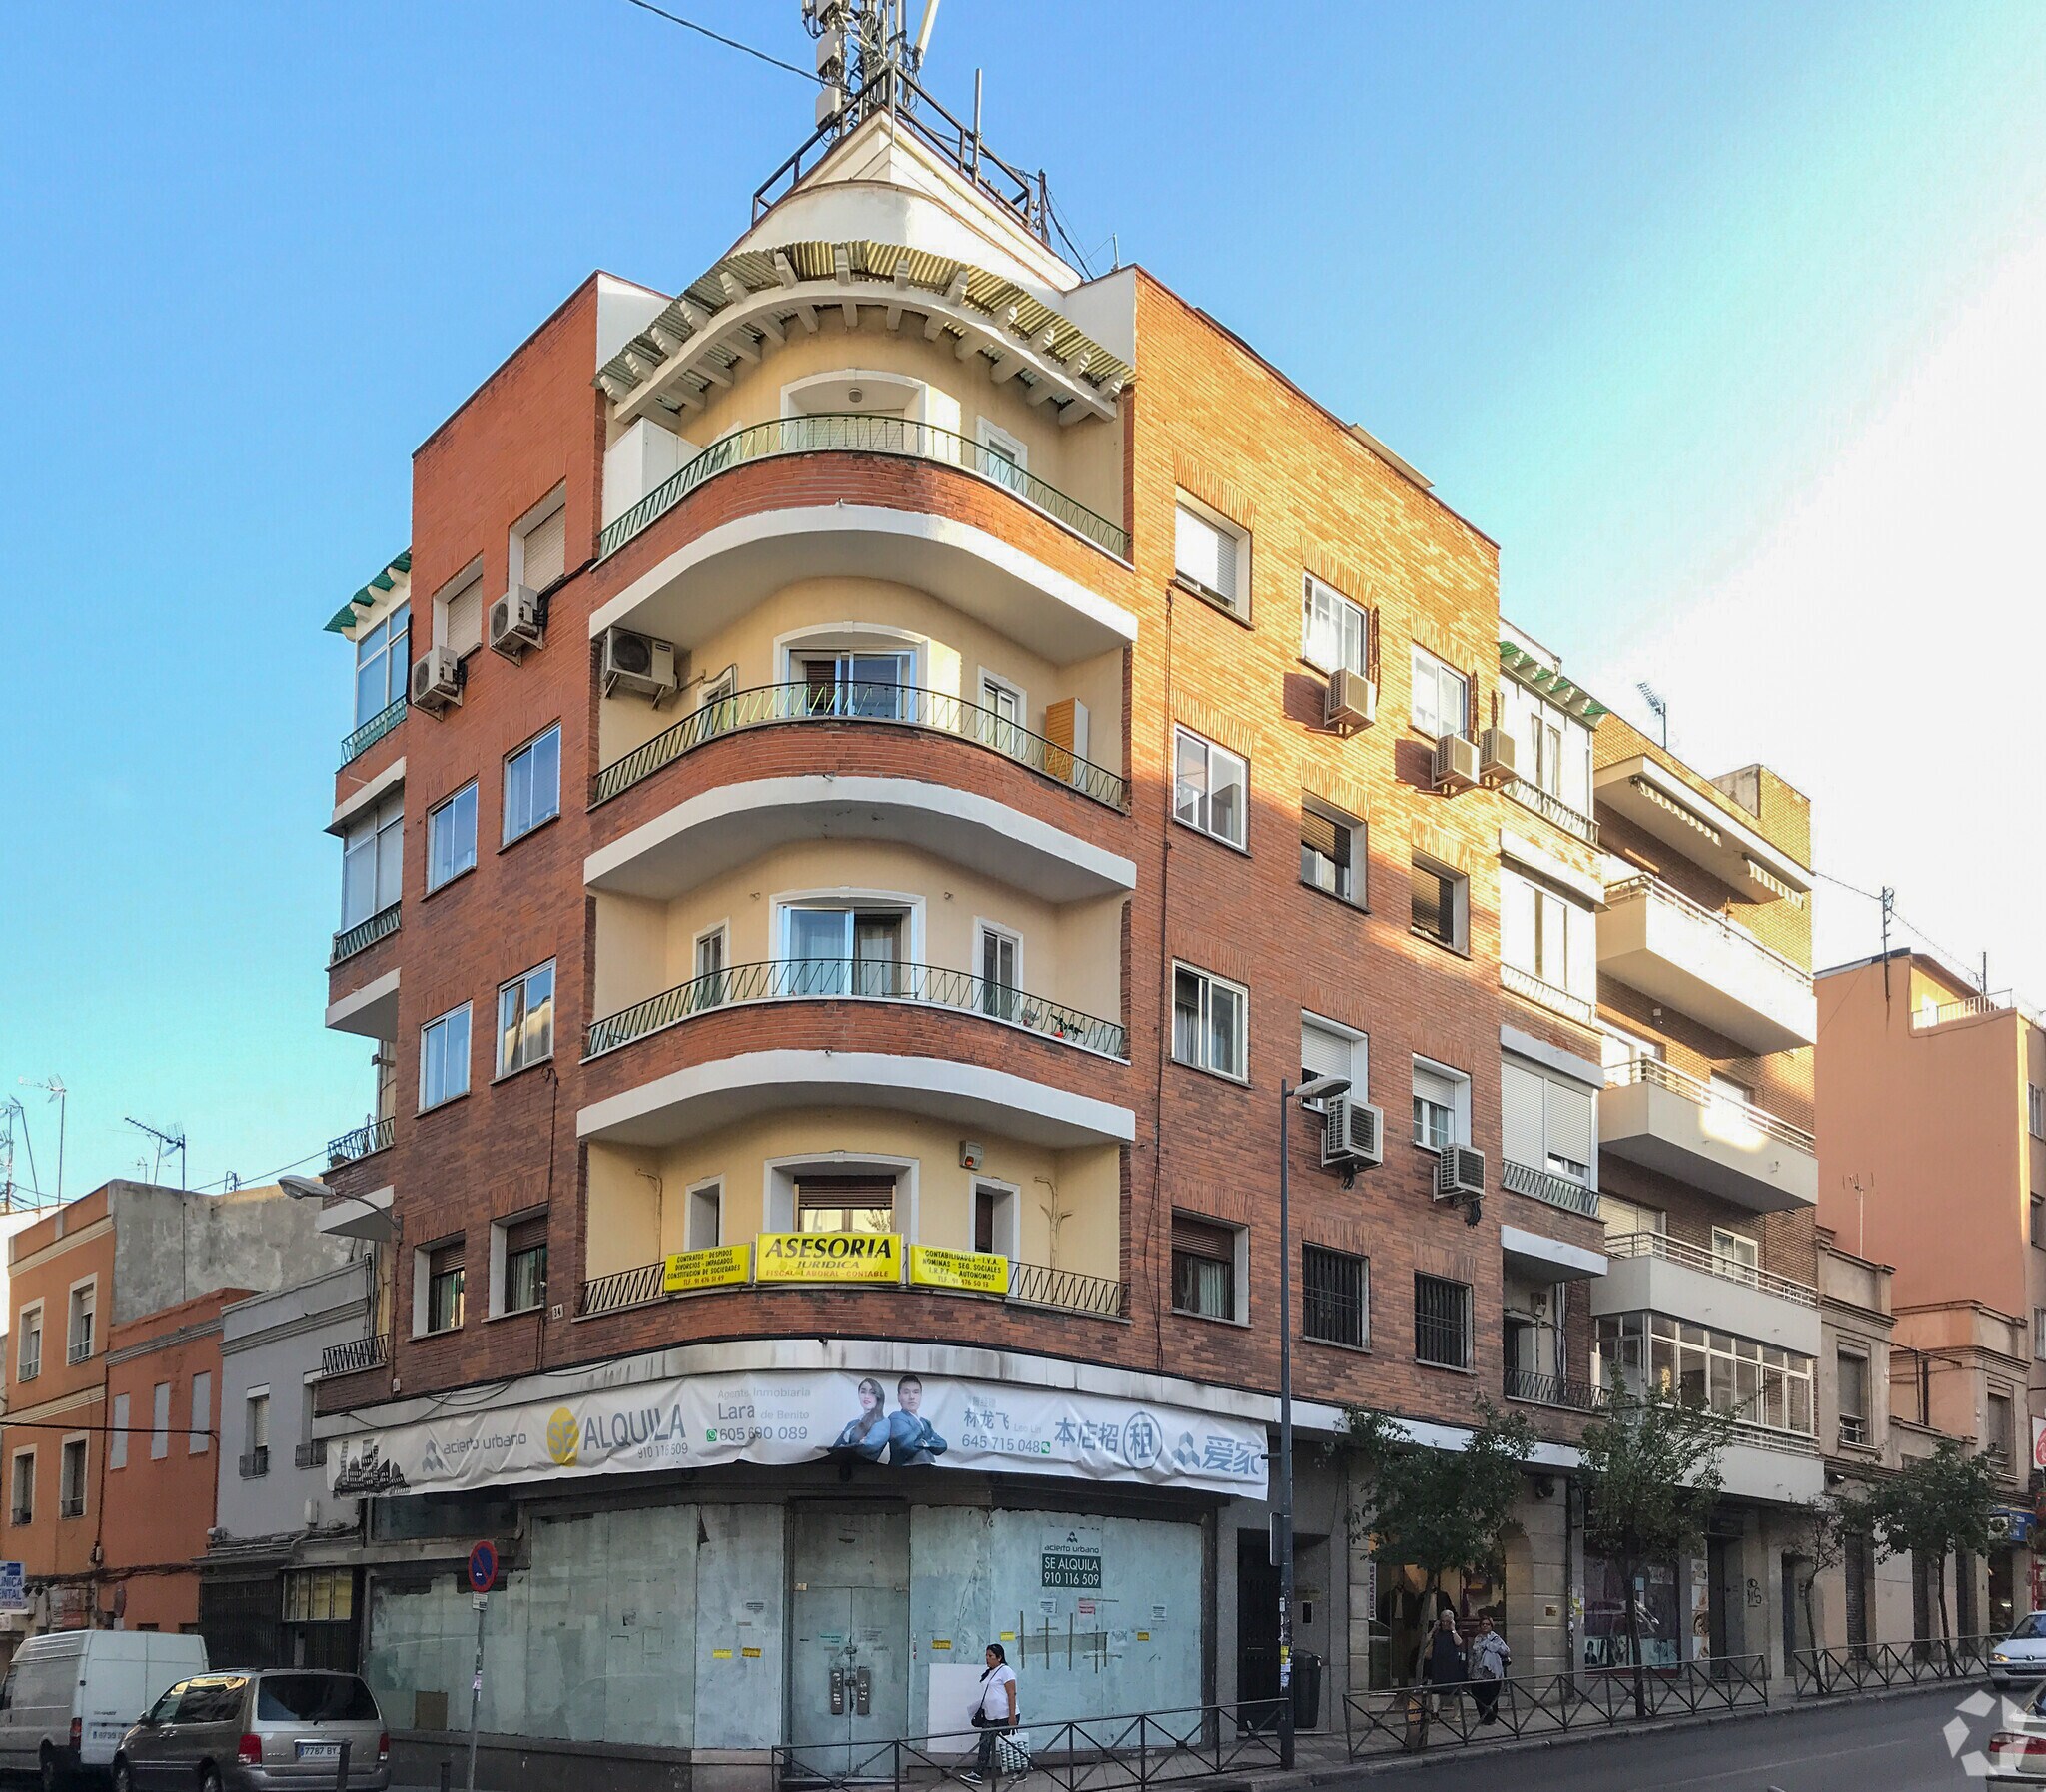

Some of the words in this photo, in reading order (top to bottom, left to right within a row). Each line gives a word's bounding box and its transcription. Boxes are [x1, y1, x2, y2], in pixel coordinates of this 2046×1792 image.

[765, 1238, 891, 1259] ASESORIA
[925, 1250, 976, 1262] CONTABILIDADES
[675, 1262, 700, 1271] DIVORCIOS
[705, 1258, 733, 1267] IMPAGADOS
[676, 1254, 704, 1263] CONTRATOS
[797, 1260, 860, 1269] JURIDICA
[922, 1258, 951, 1267] NOMINAS
[973, 1264, 1001, 1273] SOCIALES
[959, 1271, 995, 1280] AUTONOMOS
[718, 1402, 755, 1420] Lara
[760, 1409, 774, 1419] de
[777, 1409, 810, 1419] Benito
[964, 1408, 1010, 1430] 林龙飞
[548, 1420, 576, 1454] SE
[583, 1404, 686, 1451] ALQUILA
[719, 1427, 745, 1441] 605
[778, 1426, 808, 1439] 089
[482, 1432, 527, 1449] urbano
[962, 1434, 988, 1449] 645
[992, 1436, 1015, 1451] 715
[1018, 1438, 1040, 1453] 048
[638, 1446, 653, 1459] 910
[670, 1442, 688, 1456] 509
[1202, 1435, 1262, 1475] 爱家
[1044, 1544, 1071, 1553] acierto
[1072, 1544, 1099, 1554] urbano
[1044, 1557, 1056, 1569] SE
[1058, 1559, 1099, 1571] ALQUILA
[1044, 1572, 1062, 1584] 910
[1064, 1573, 1079, 1585] 116
[1081, 1574, 1099, 1586] 509
[305, 1747, 325, 1756] 7787
